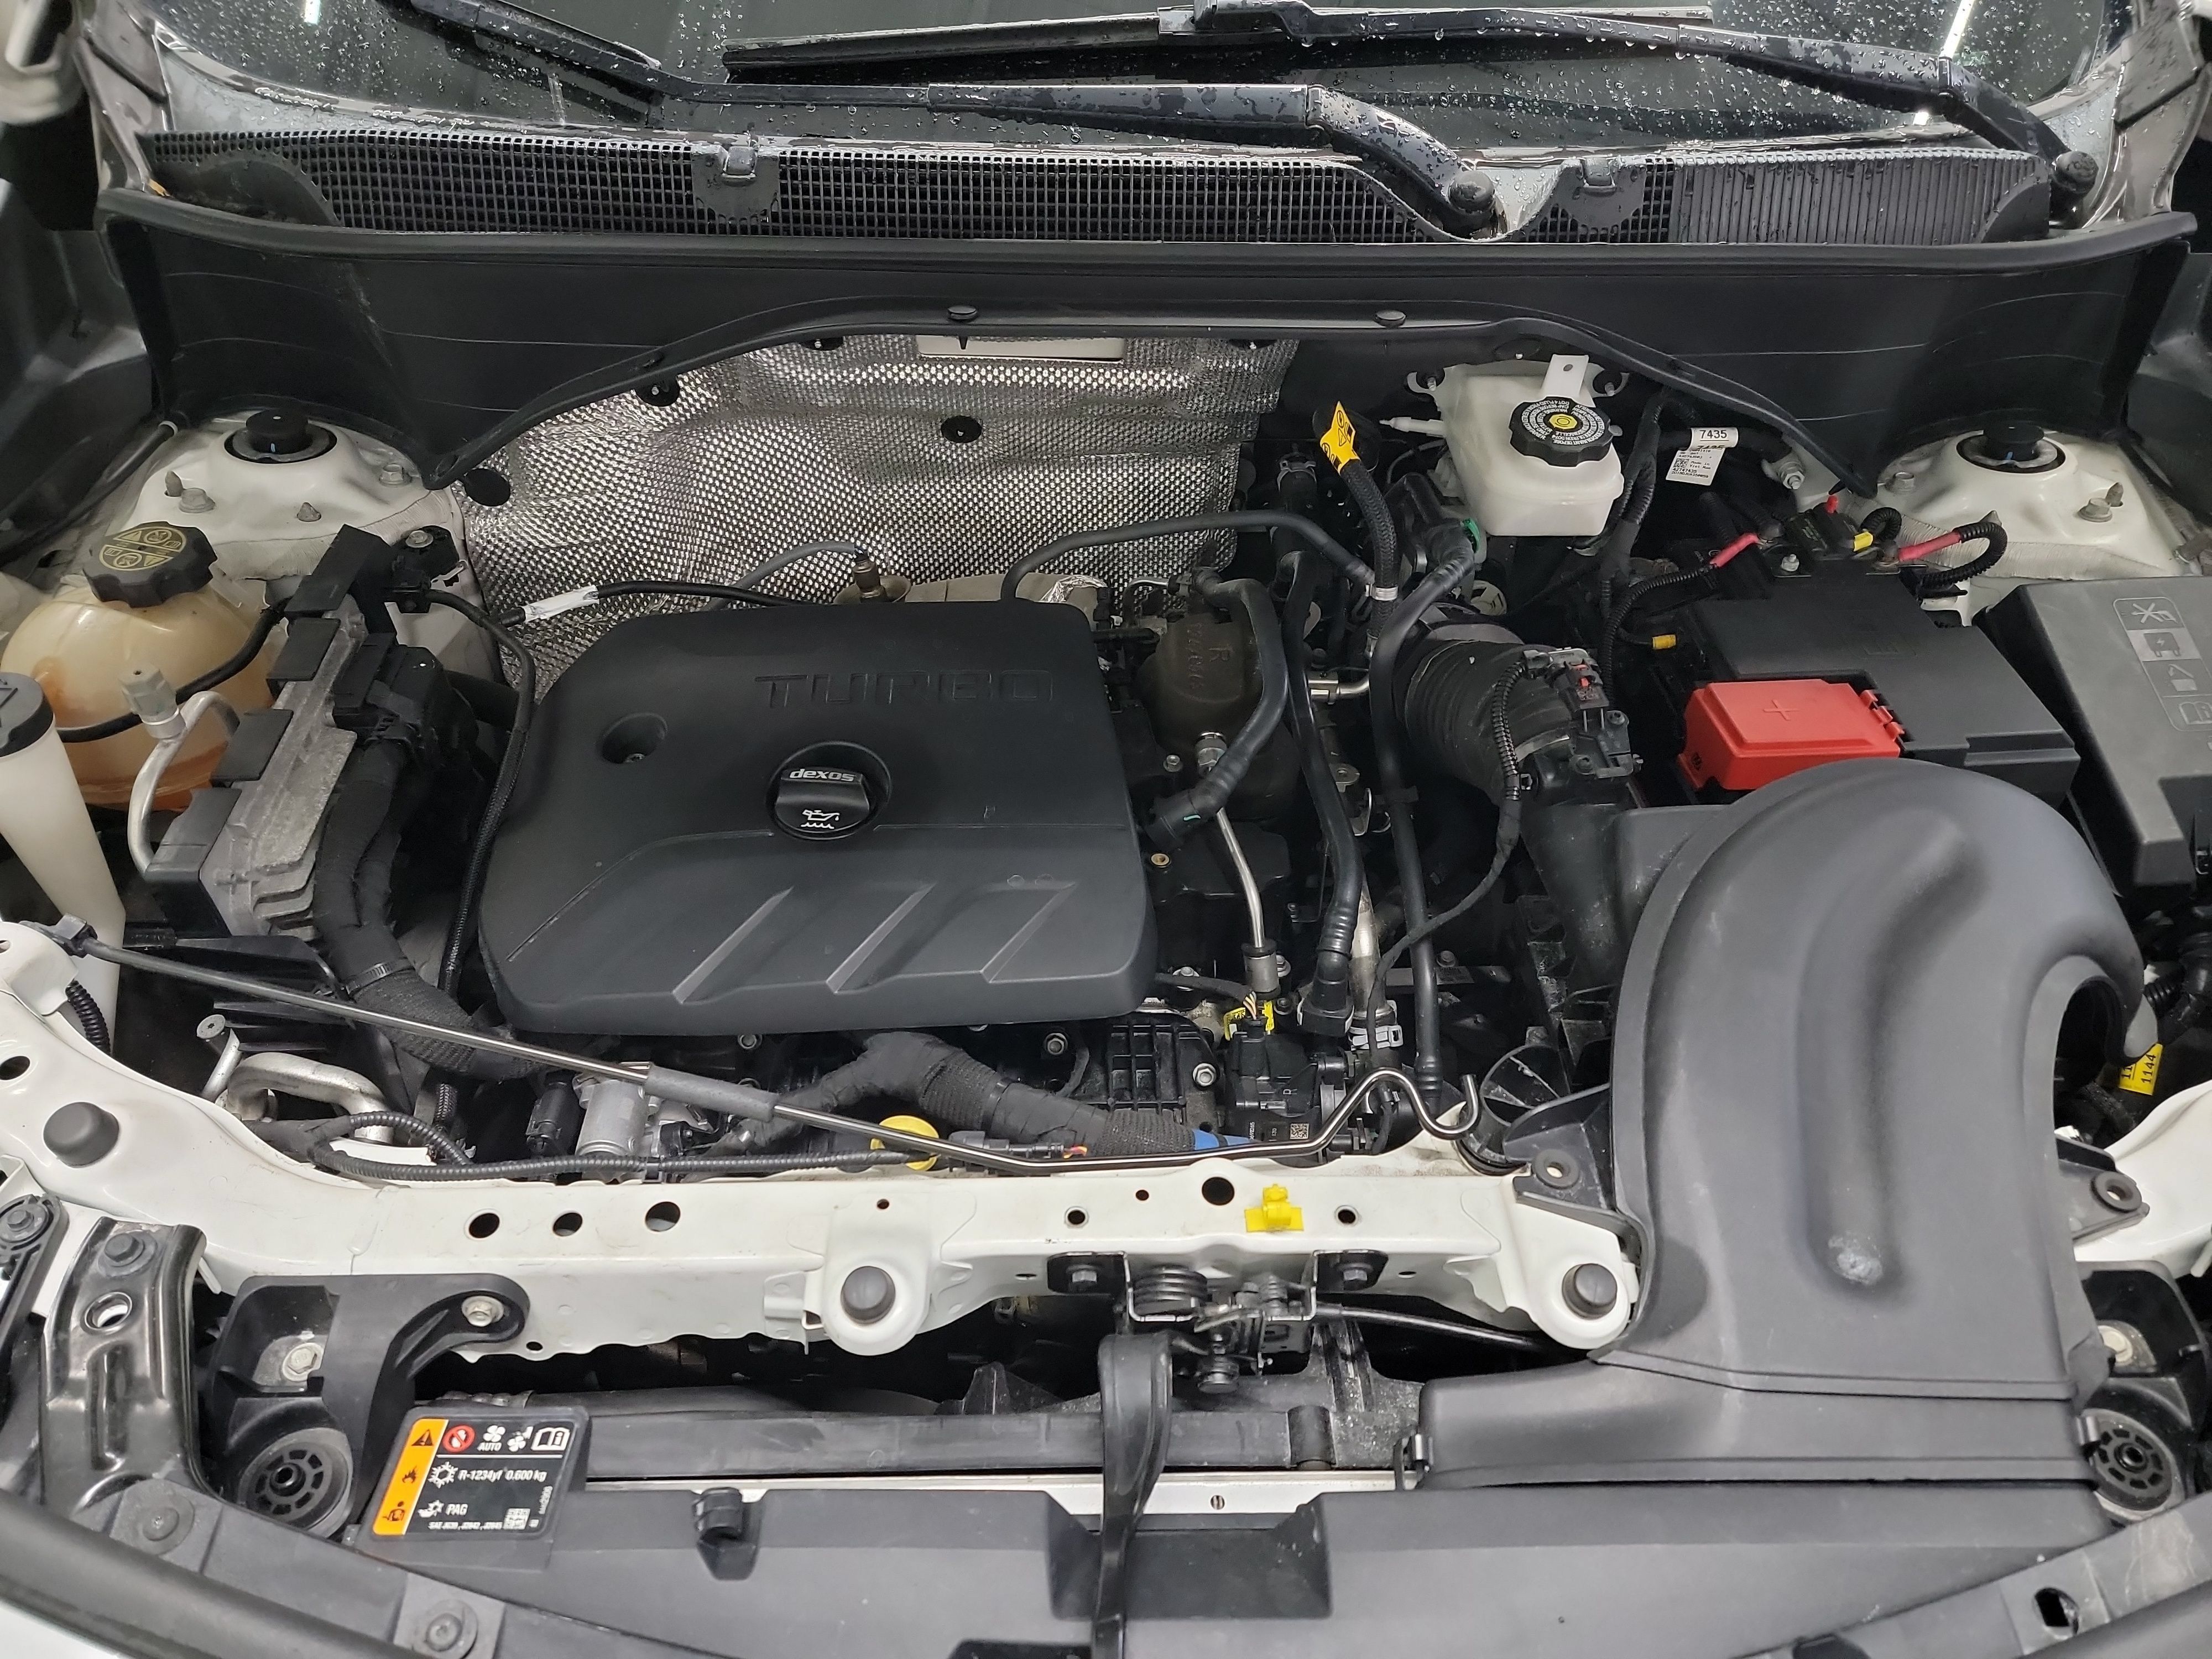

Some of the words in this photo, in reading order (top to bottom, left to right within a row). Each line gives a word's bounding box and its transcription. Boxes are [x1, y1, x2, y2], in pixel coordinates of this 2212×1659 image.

[1699, 430, 1728, 439] 7435
[754, 669, 1053, 708] TURBO
[789, 768, 855, 782] dexos
[2140, 1054, 2156, 1084] 1144
[477, 1442, 502, 1452] AUTO
[458, 1469, 503, 1483] R-1234yf
[504, 1470, 533, 1481] 0.600
[533, 1470, 547, 1483] kg
[445, 1504, 468, 1516] PAG
